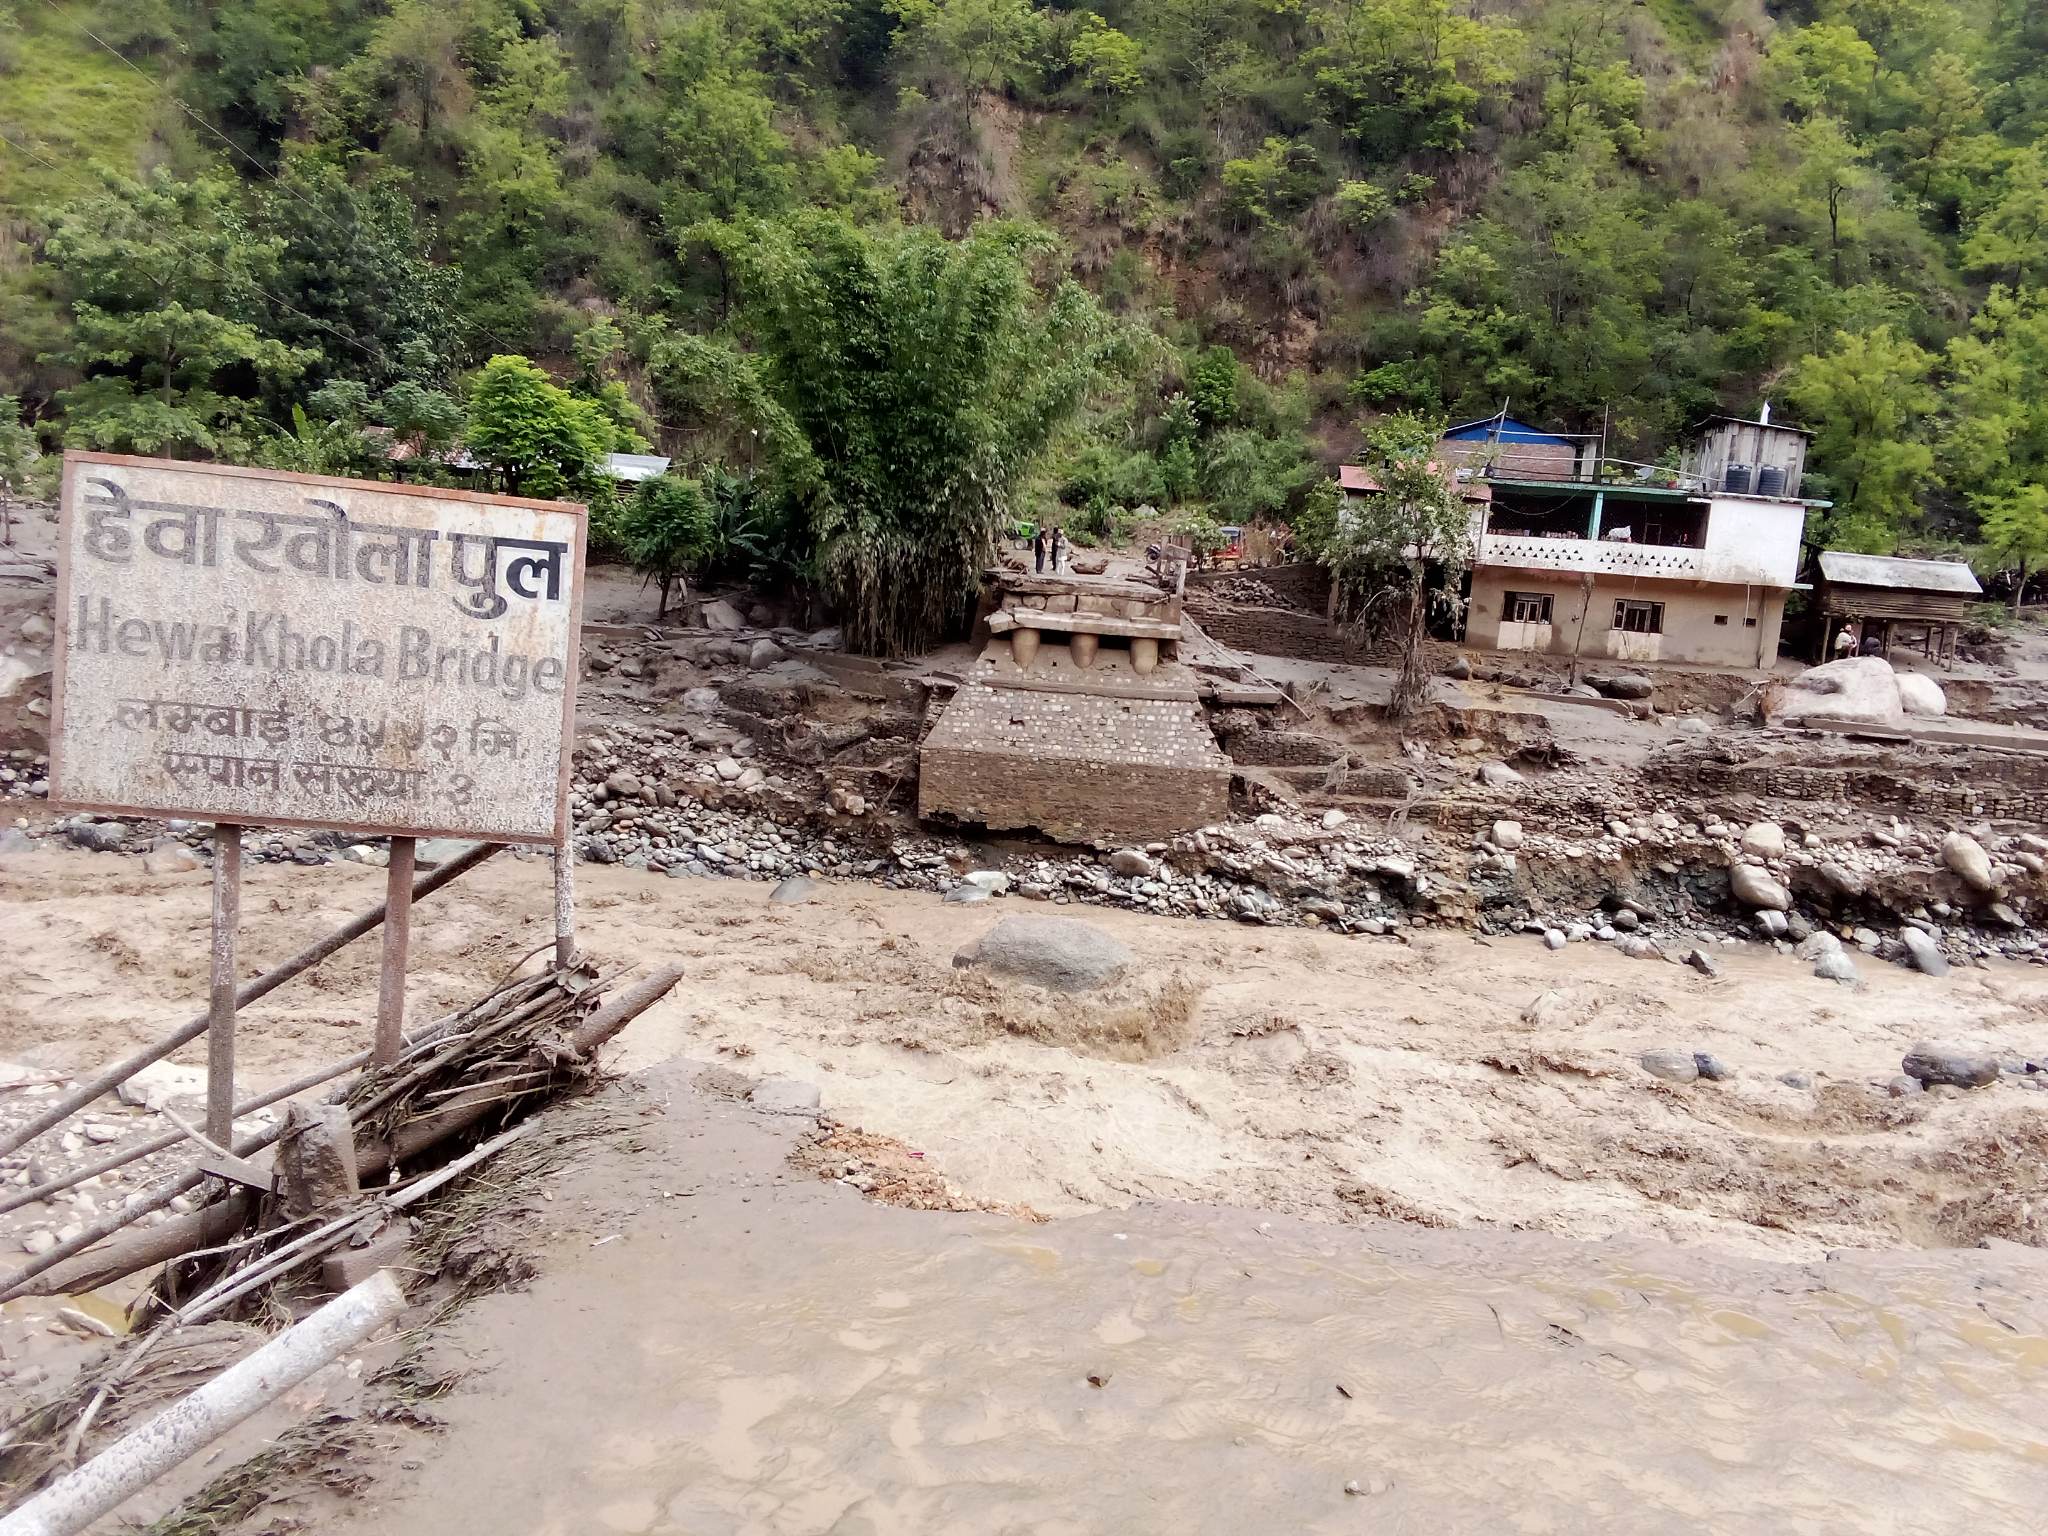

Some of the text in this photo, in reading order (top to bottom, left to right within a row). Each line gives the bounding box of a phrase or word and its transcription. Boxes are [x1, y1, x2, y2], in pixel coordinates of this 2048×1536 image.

[446, 532, 568, 620] पुल
[75, 595, 564, 701] Hewa Khola Bridge
